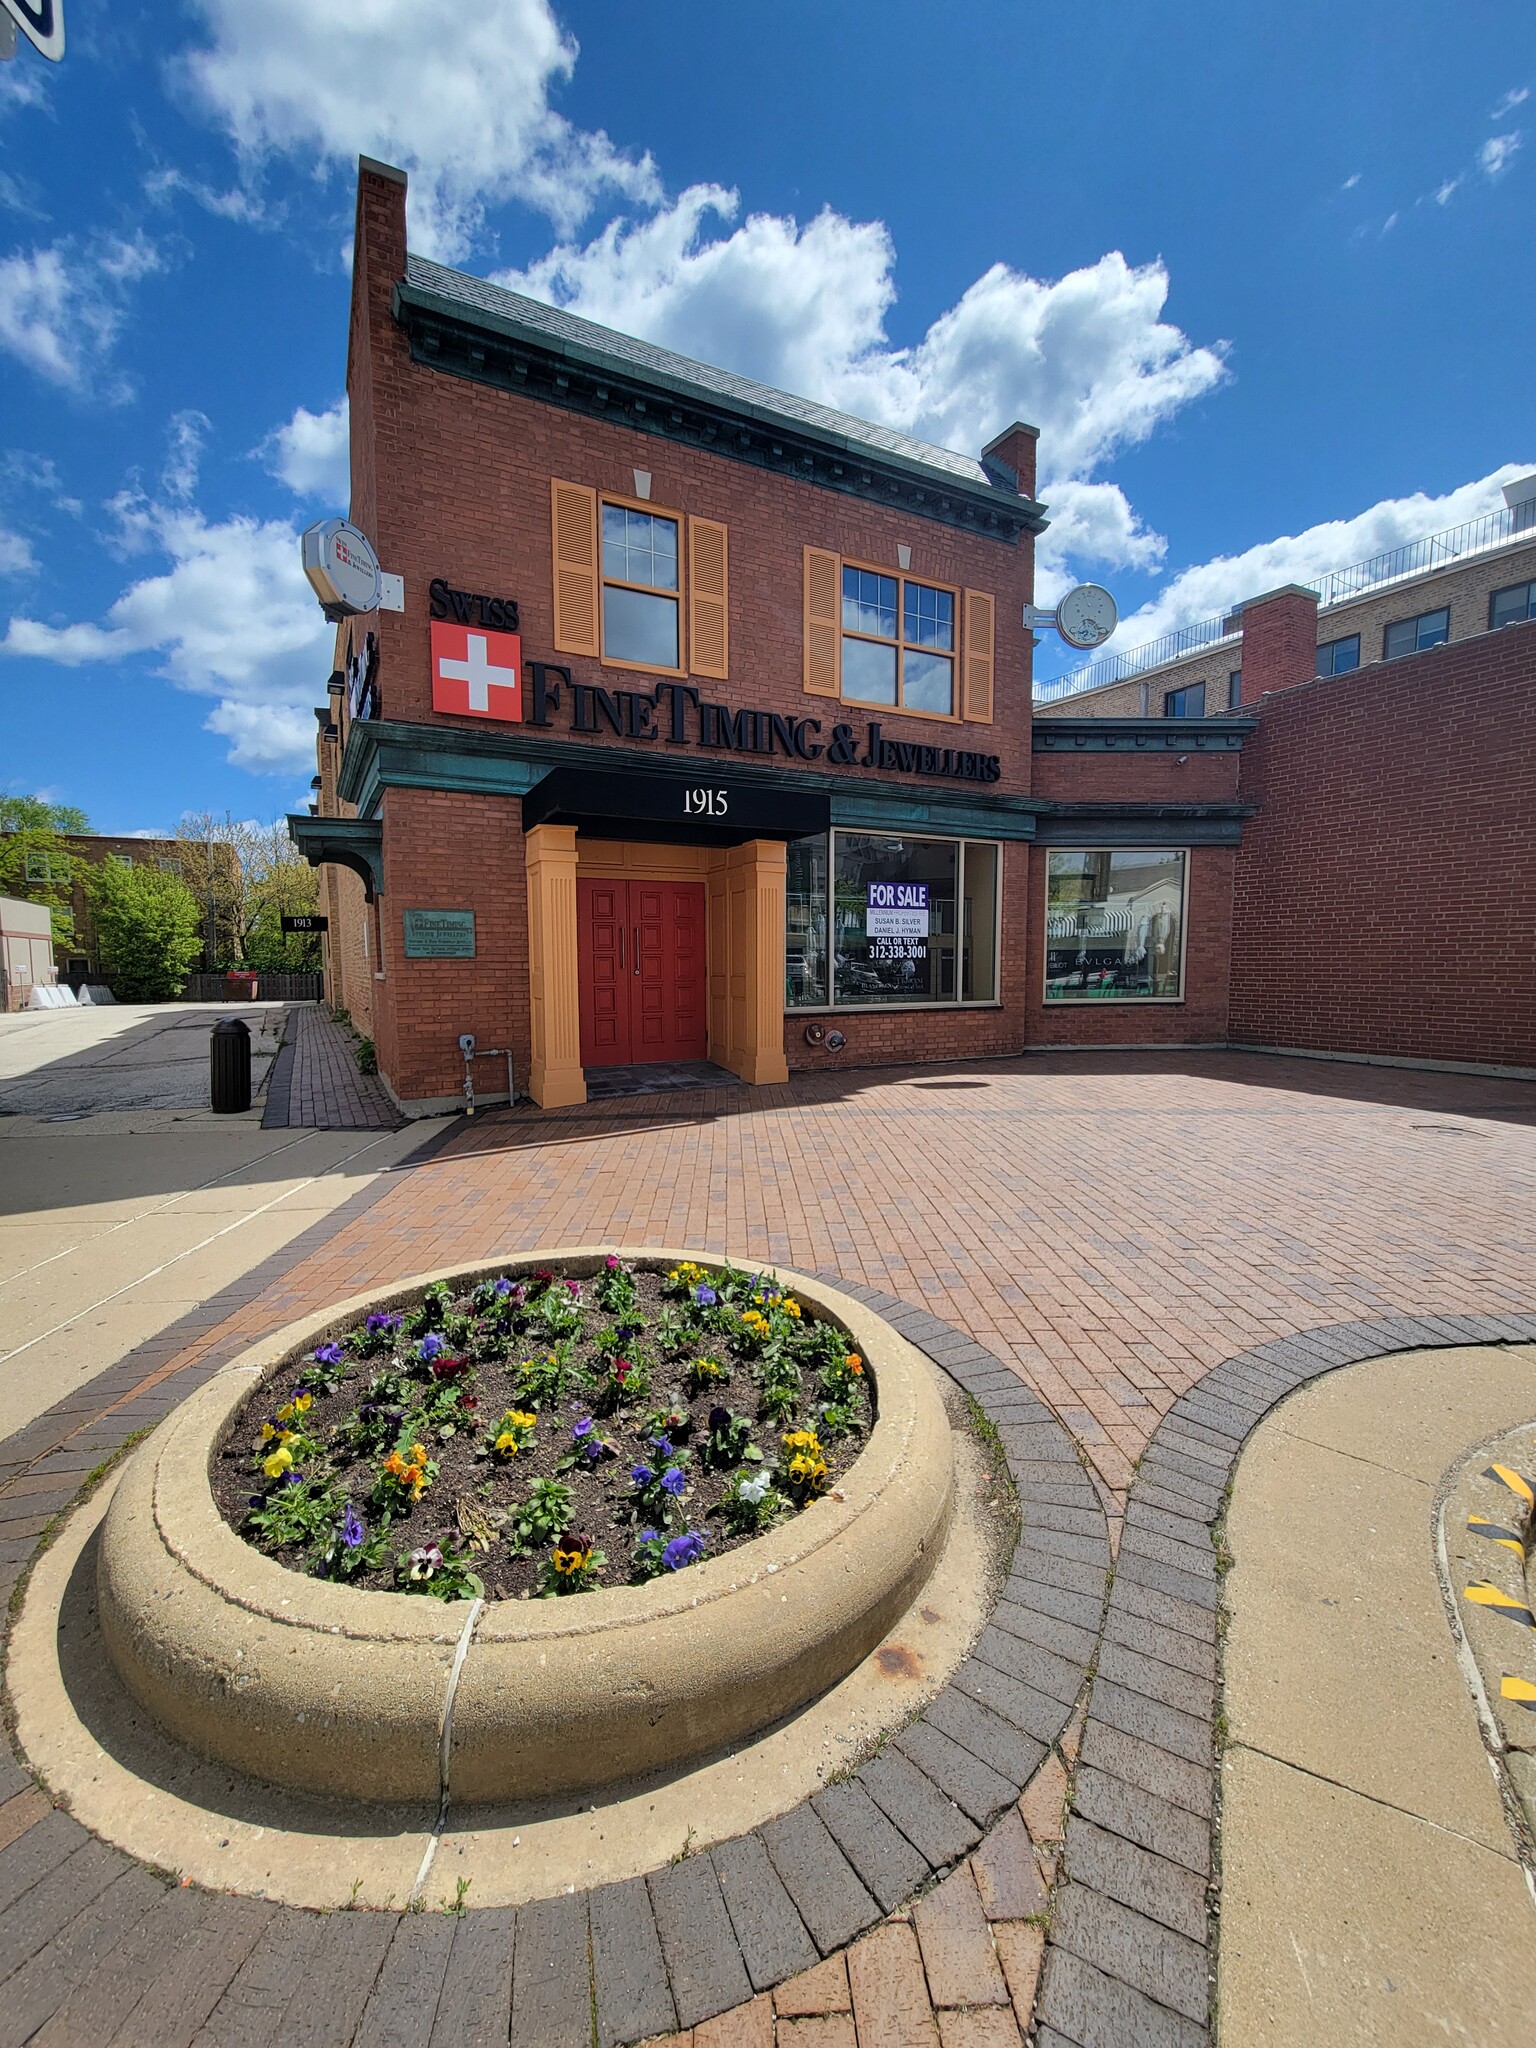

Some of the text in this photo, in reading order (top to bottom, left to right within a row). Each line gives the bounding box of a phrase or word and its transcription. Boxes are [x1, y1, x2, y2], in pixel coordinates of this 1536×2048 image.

[827, 723, 861, 765] &
[861, 722, 1000, 783] JEWELLERS
[683, 788, 728, 816] 1915
[870, 884, 926, 907] FOR SALE
[293, 918, 312, 928] 1913
[876, 937, 892, 945] CALL
[869, 945, 927, 959] 312-338-3001
